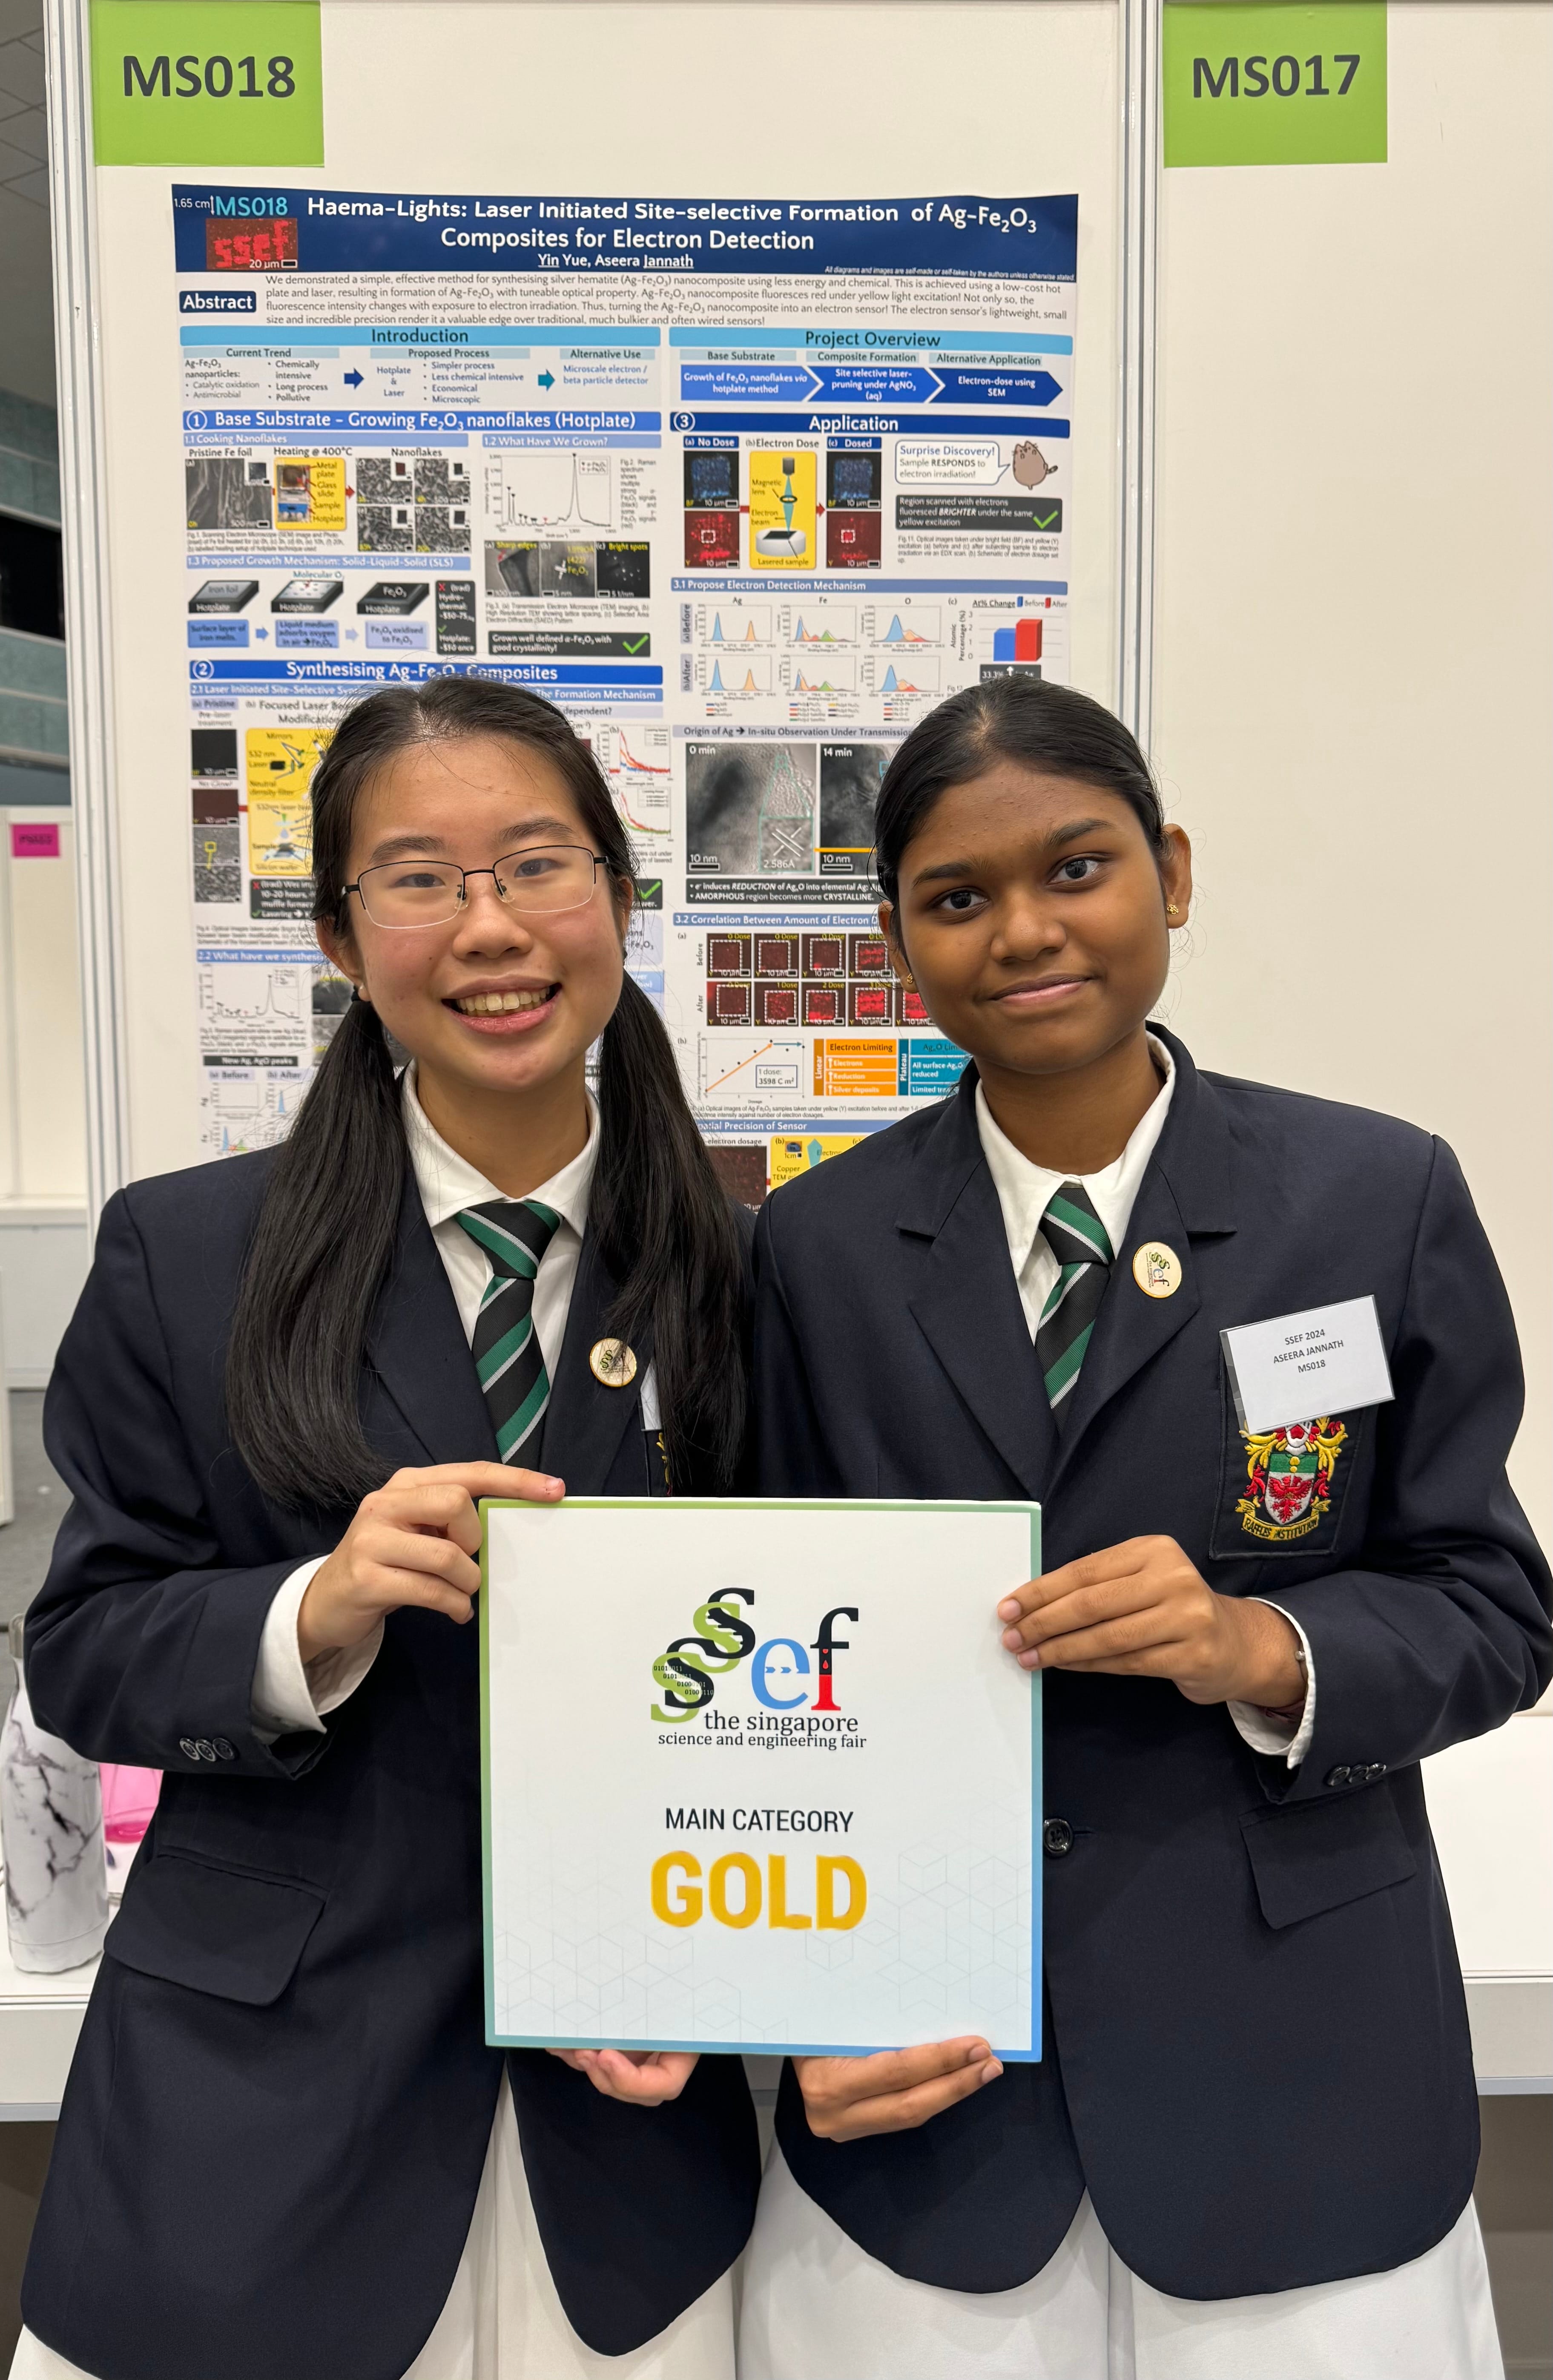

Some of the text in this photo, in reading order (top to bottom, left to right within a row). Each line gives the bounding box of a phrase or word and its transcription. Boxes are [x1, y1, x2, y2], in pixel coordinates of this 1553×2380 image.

[123, 56, 295, 97] MS018
[1193, 55, 1360, 97] MS017
[174, 198, 192, 208] 1.65
[216, 197, 287, 216] MS018
[309, 198, 467, 221] Haema-Lights:
[475, 202, 533, 218] Laser
[539, 202, 628, 219] Initiated
[634, 204, 782, 221] Site-selective
[789, 205, 899, 221] Formation
[911, 203, 934, 221] of
[442, 228, 815, 253] Composites for Electron Detection
[249, 258, 263, 268] 20
[538, 253, 693, 268] Yin Yue, Aseera Jannath
[265, 276, 283, 284] We
[285, 274, 350, 284] demonstrated
[360, 274, 393, 286] simple,
[395, 273, 435, 283] effective
[437, 274, 474, 283] method
[476, 273, 489, 283] for
[491, 274, 548, 286] synthesising
[551, 274, 575, 283] silver
[577, 275, 618, 284] hematite
[183, 293, 253, 310] Abstract
[372, 328, 468, 342] Introduction
[806, 330, 941, 350] Project Overview
[226, 348, 291, 359] Current Trend
[408, 348, 490, 359] Proposed Process
[570, 349, 641, 361] Alternative Use
[708, 351, 775, 362] Base Substrate
[818, 352, 916, 364] Composite Formation
[936, 354, 1040, 366] Alternative Application
[216, 412, 251, 426] Base
[256, 411, 331, 426] Substrate
[349, 412, 416, 431] Growing
[467, 412, 551, 428] nanoflakes
[555, 411, 636, 432] (Hotplate)
[809, 417, 899, 434] Application
[184, 434, 287, 445] 1.1 Cooking Nanoflakes
[485, 436, 609, 449] 1.2 What Have We Grown?
[698, 438, 735, 447] No Dose
[756, 438, 819, 448] Electron Dose
[845, 439, 872, 448] Dosed
[189, 448, 222, 457] Pristine
[238, 448, 252, 457] foil
[273, 447, 310, 458] Heating
[313, 448, 319, 457] @
[391, 447, 442, 457] Nanoflakes
[900, 446, 995, 458] Surprise Discovery!
[900, 459, 929, 467] Sample
[933, 470, 976, 480] irradiation!
[188, 555, 455, 569] 1.3 Proposed Growth Mechanism: Solid-Liquid-Solid (SLS)
[674, 580, 866, 591] 3.1 Propose Electron Detection Mechanism
[287, 661, 385, 680] Synthesising
[555, 690, 655, 700] Formation Mechanism
[684, 727, 734, 739] Origin of Ag
[778, 727, 829, 739] Observation
[831, 728, 857, 739] Under
[689, 746, 716, 755] 0 min
[823, 748, 853, 757] 14 min
[690, 854, 701, 862] 10
[823, 854, 834, 863] 10
[676, 915, 689, 923] 3.2
[691, 915, 741, 923] Correlation
[743, 916, 781, 924] Between
[821, 915, 830, 924] of
[832, 916, 868, 924] Electron
[862, 1044, 893, 1052] Limiting
[725, 1121, 807, 1131] Precision of Sensor
[777, 1165, 800, 1174] Copper
[1285, 1329, 1325, 1345] SSEF 2024
[1274, 1340, 1344, 1364] ASEERA JANNATH
[1298, 1360, 1326, 1373] MS018
[704, 1710, 858, 1736] the singapore
[658, 1731, 867, 1751] science and engineering fair
[666, 1808, 853, 1832] MAIN CATEGORY
[649, 1848, 869, 1933] GOLD
